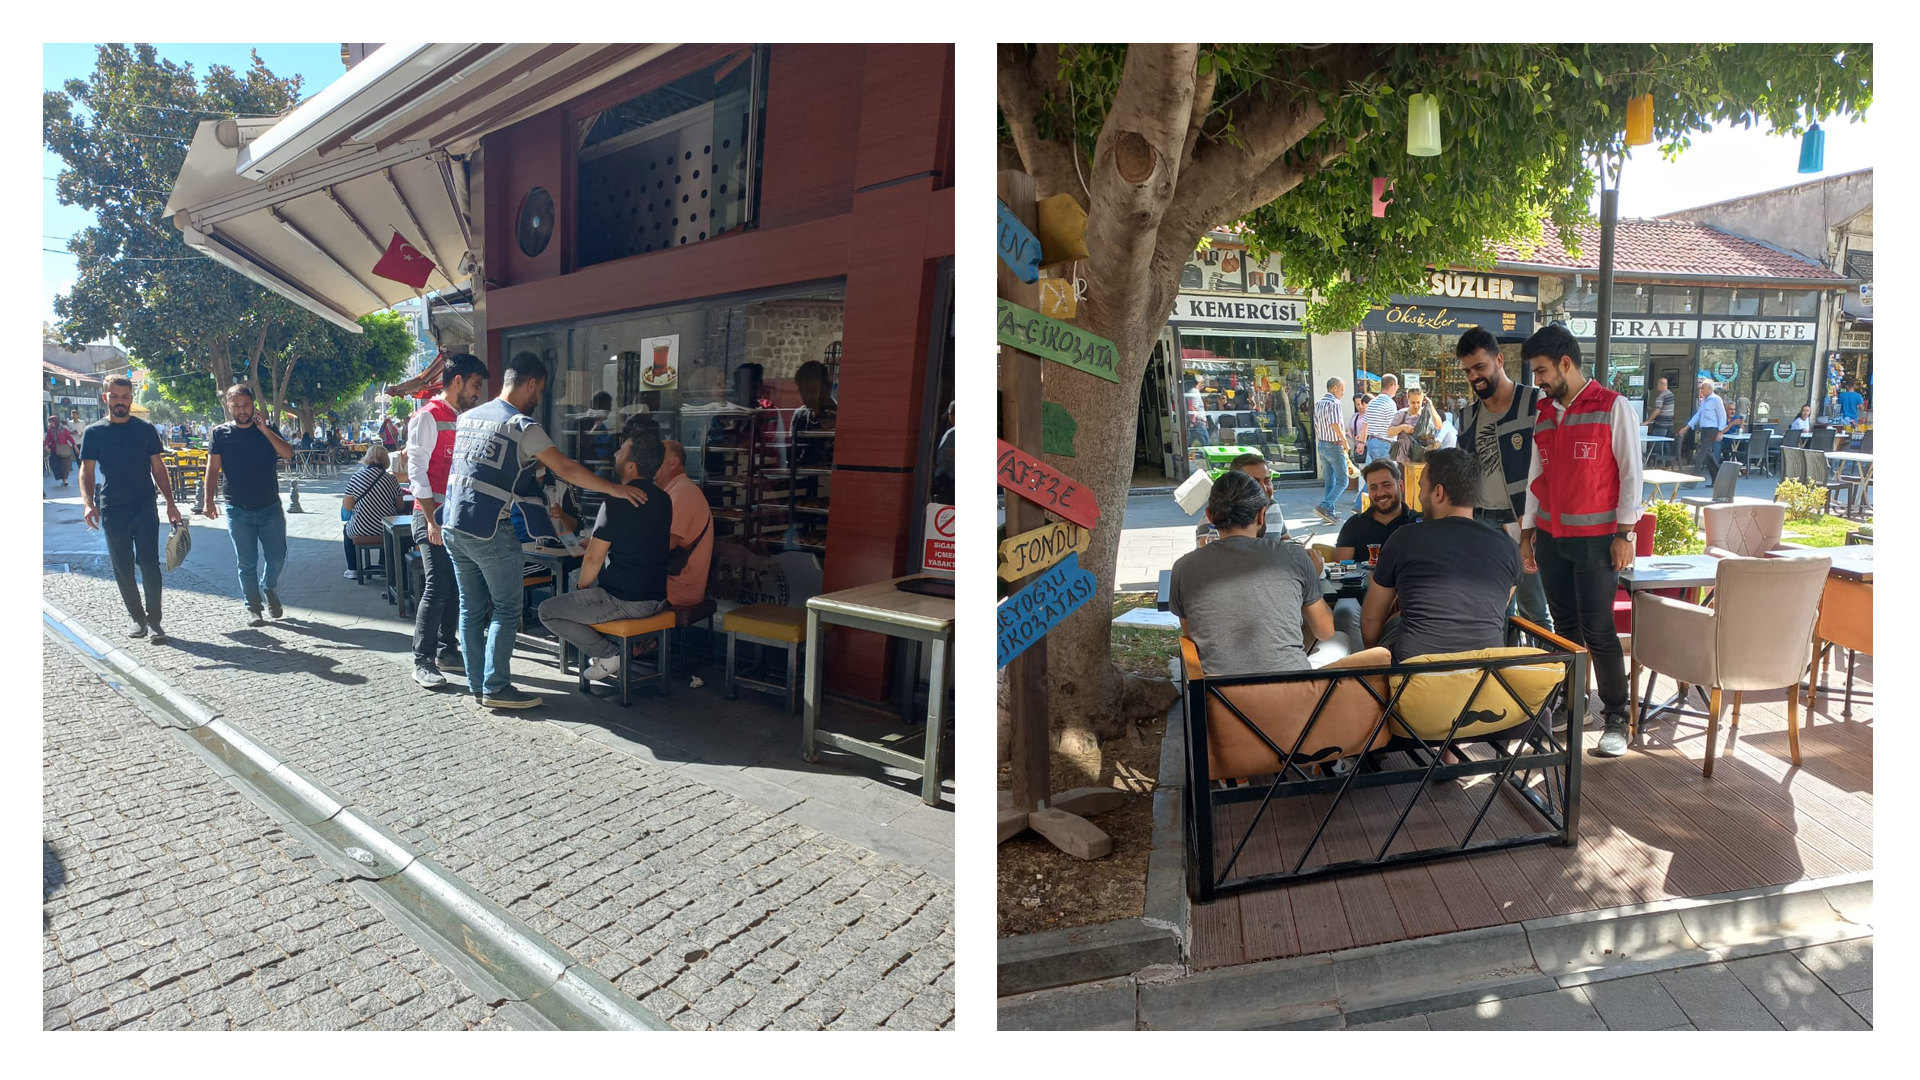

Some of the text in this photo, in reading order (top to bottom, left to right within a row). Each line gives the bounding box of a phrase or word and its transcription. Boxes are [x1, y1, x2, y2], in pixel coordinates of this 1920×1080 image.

[997, 214, 1030, 261] EN
[1189, 300, 1297, 321] KEMERCİSİ
[1386, 305, 1455, 329] Öksüzler
[1593, 320, 1686, 337] ERAH
[1711, 321, 1806, 339] KÜNEFE
[1013, 522, 1078, 571] FONDÜ
